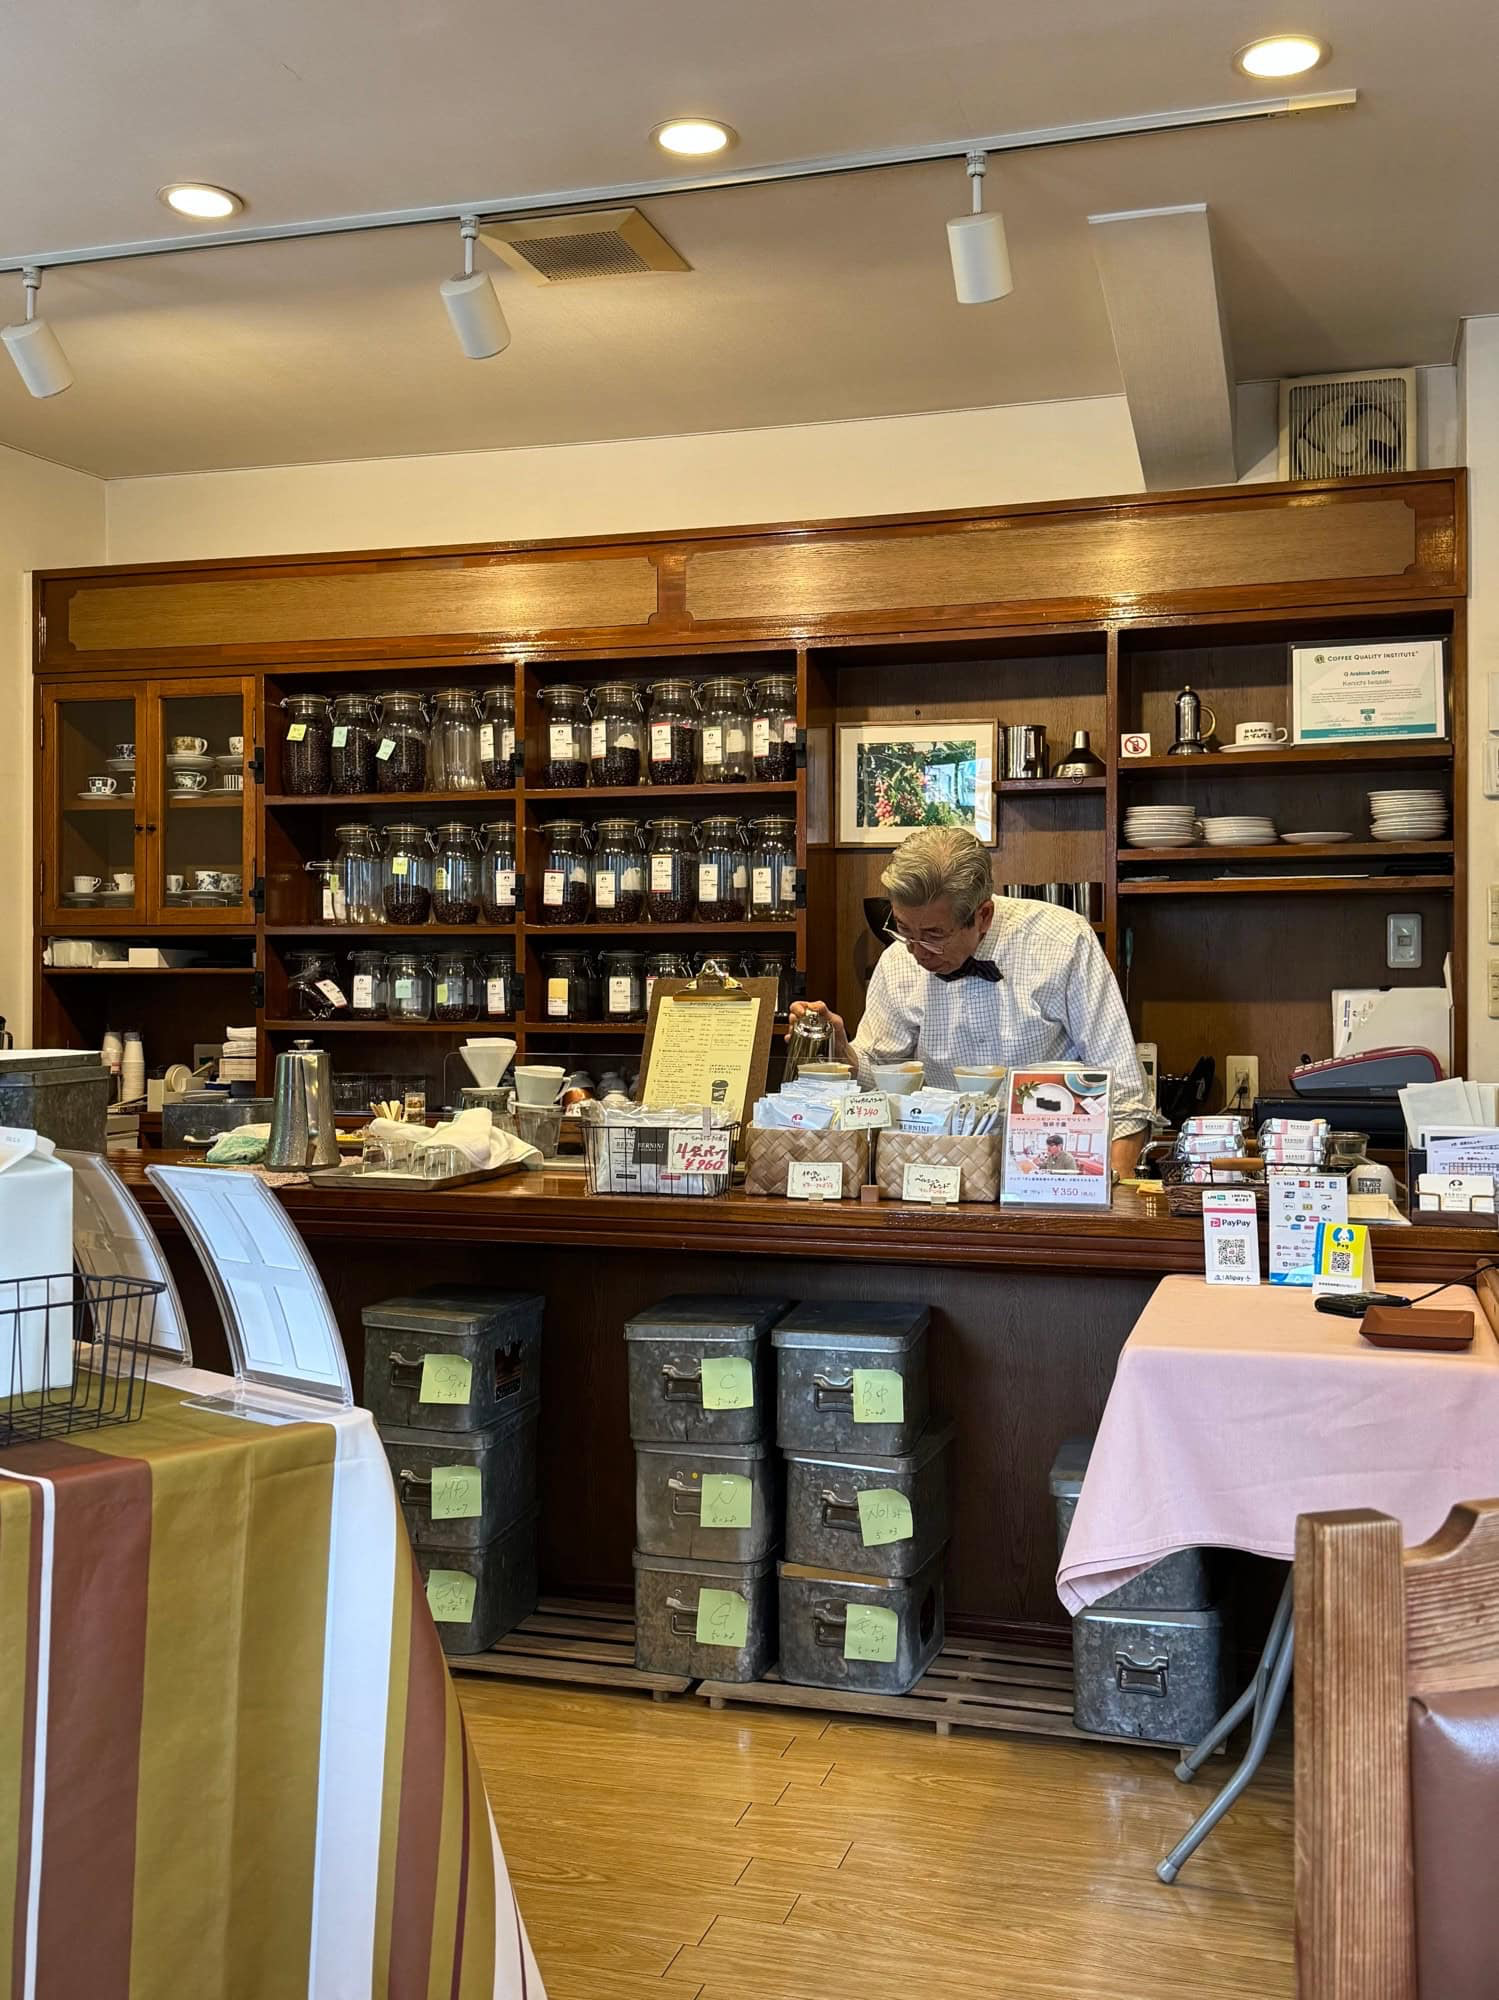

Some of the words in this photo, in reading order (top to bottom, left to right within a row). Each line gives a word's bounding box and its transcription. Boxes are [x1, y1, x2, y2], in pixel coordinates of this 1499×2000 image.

[1354, 653, 1381, 661] QUALITY
[856, 1105, 879, 1117] ¥240
[684, 1158, 724, 1171] ¥960
[1052, 1187, 1079, 1196] ¥350
[1221, 1219, 1251, 1228] PayPay
